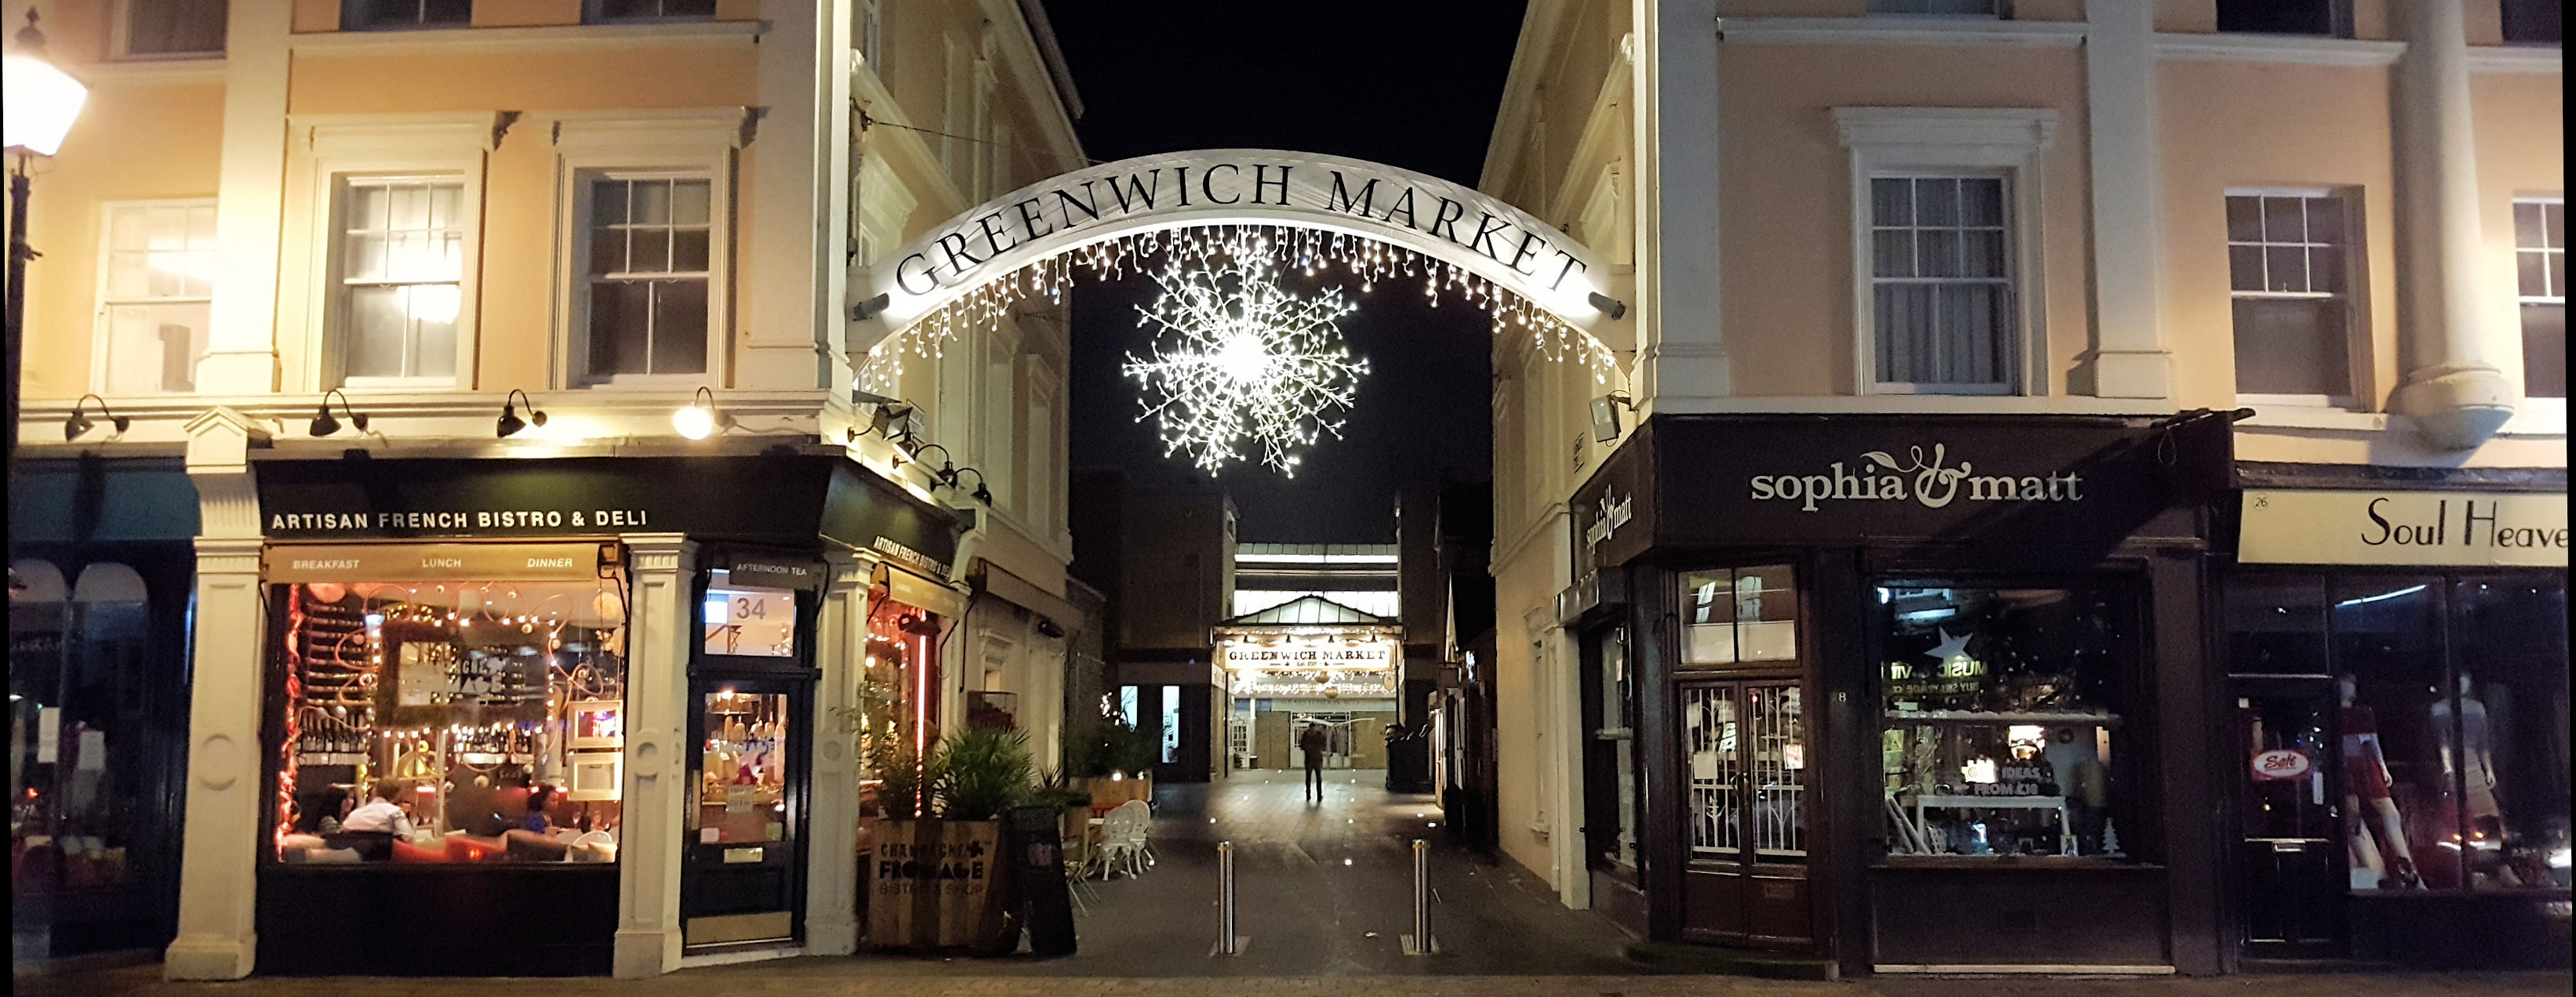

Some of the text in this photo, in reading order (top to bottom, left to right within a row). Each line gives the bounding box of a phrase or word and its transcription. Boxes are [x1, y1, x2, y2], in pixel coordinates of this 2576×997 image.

[896, 163, 1587, 296] GREENWICH MARKET
[1751, 462, 1908, 512] sophia
[1968, 470, 2084, 501] matt
[2254, 497, 2268, 508] 26
[272, 510, 647, 529] ARTISAN FRENCH BISTRO & DELI
[1586, 509, 1606, 555] sophia
[1614, 491, 1632, 529] matt
[2360, 497, 2447, 546] Soul
[873, 536, 900, 557] ARTISAN
[898, 546, 921, 565] FRENCH
[292, 560, 360, 570] BREAKFAST
[423, 558, 462, 567] LUNCH
[527, 557, 573, 567] DINNER
[736, 564, 807, 576] AFTERNOON TEA
[736, 597, 766, 620] 34
[1229, 651, 1386, 660] GREENWICH MARKET
[2002, 767, 2041, 778] IDEAS
[1975, 783, 2013, 796] FROM
